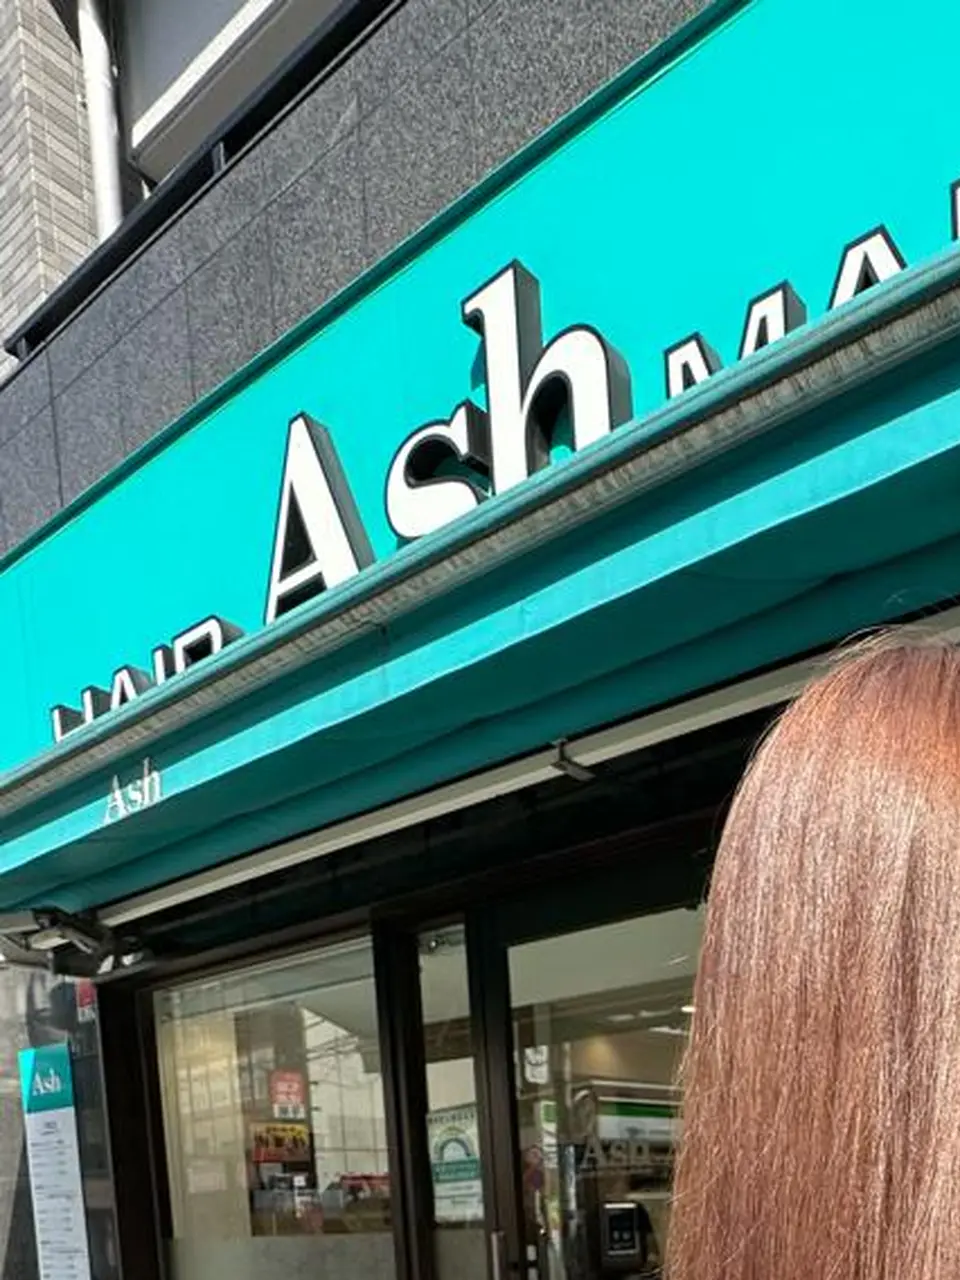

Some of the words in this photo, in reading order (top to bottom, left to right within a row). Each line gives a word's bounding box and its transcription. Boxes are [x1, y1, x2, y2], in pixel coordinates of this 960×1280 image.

[264, 258, 634, 626] Ash
[103, 756, 162, 825] Ash
[32, 1068, 62, 1098] Ash
